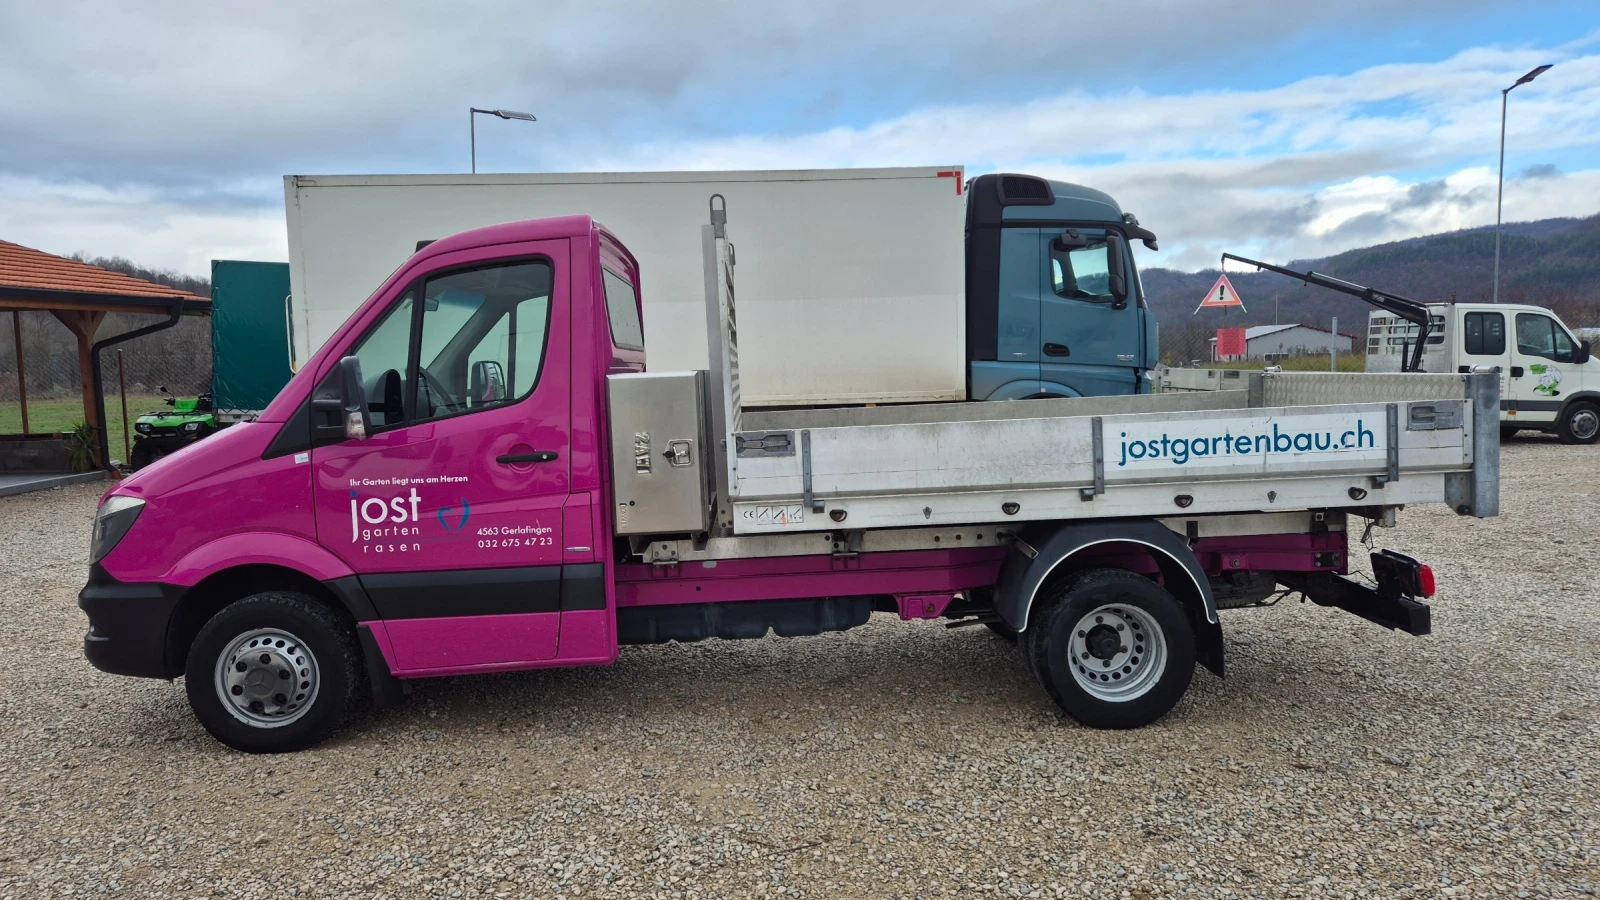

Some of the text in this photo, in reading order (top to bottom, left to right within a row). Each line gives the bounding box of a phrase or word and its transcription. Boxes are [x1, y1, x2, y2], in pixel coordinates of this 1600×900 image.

[1118, 419, 1376, 467] jostgartenbau.ch
[350, 478, 361, 487] Ihr
[362, 478, 390, 486] Garten
[391, 476, 409, 486] liegt
[440, 475, 469, 483] Herzen
[350, 487, 422, 544] jost
[362, 525, 419, 541] garten
[477, 525, 552, 536] 4563 Gerlafingen
[363, 543, 421, 554] rasen
[477, 536, 553, 549] 032 675 47 23
